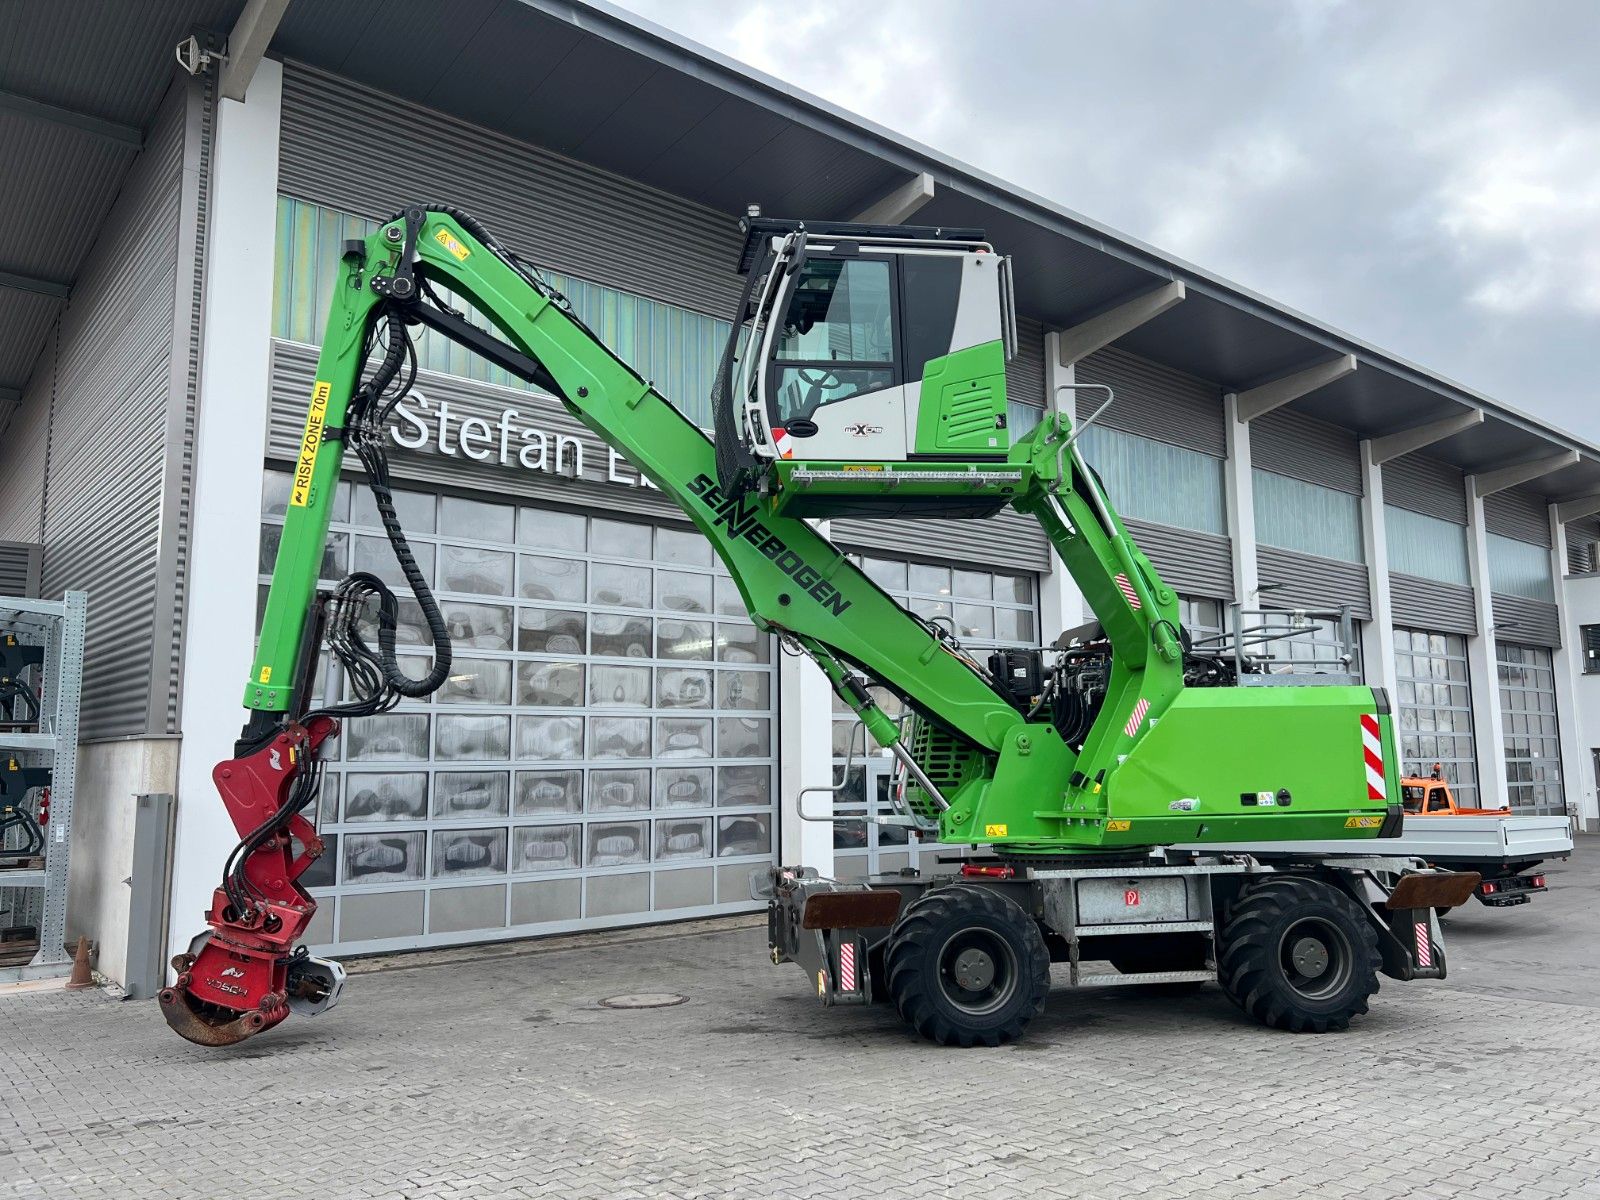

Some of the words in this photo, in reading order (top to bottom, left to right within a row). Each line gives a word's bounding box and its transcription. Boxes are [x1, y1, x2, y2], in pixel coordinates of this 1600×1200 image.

[313, 386, 328, 411] 70m
[304, 416, 322, 453] ZONE
[390, 389, 582, 477] Stefan
[297, 457, 313, 488] RISK
[686, 473, 853, 618] SENNEBOGEN
